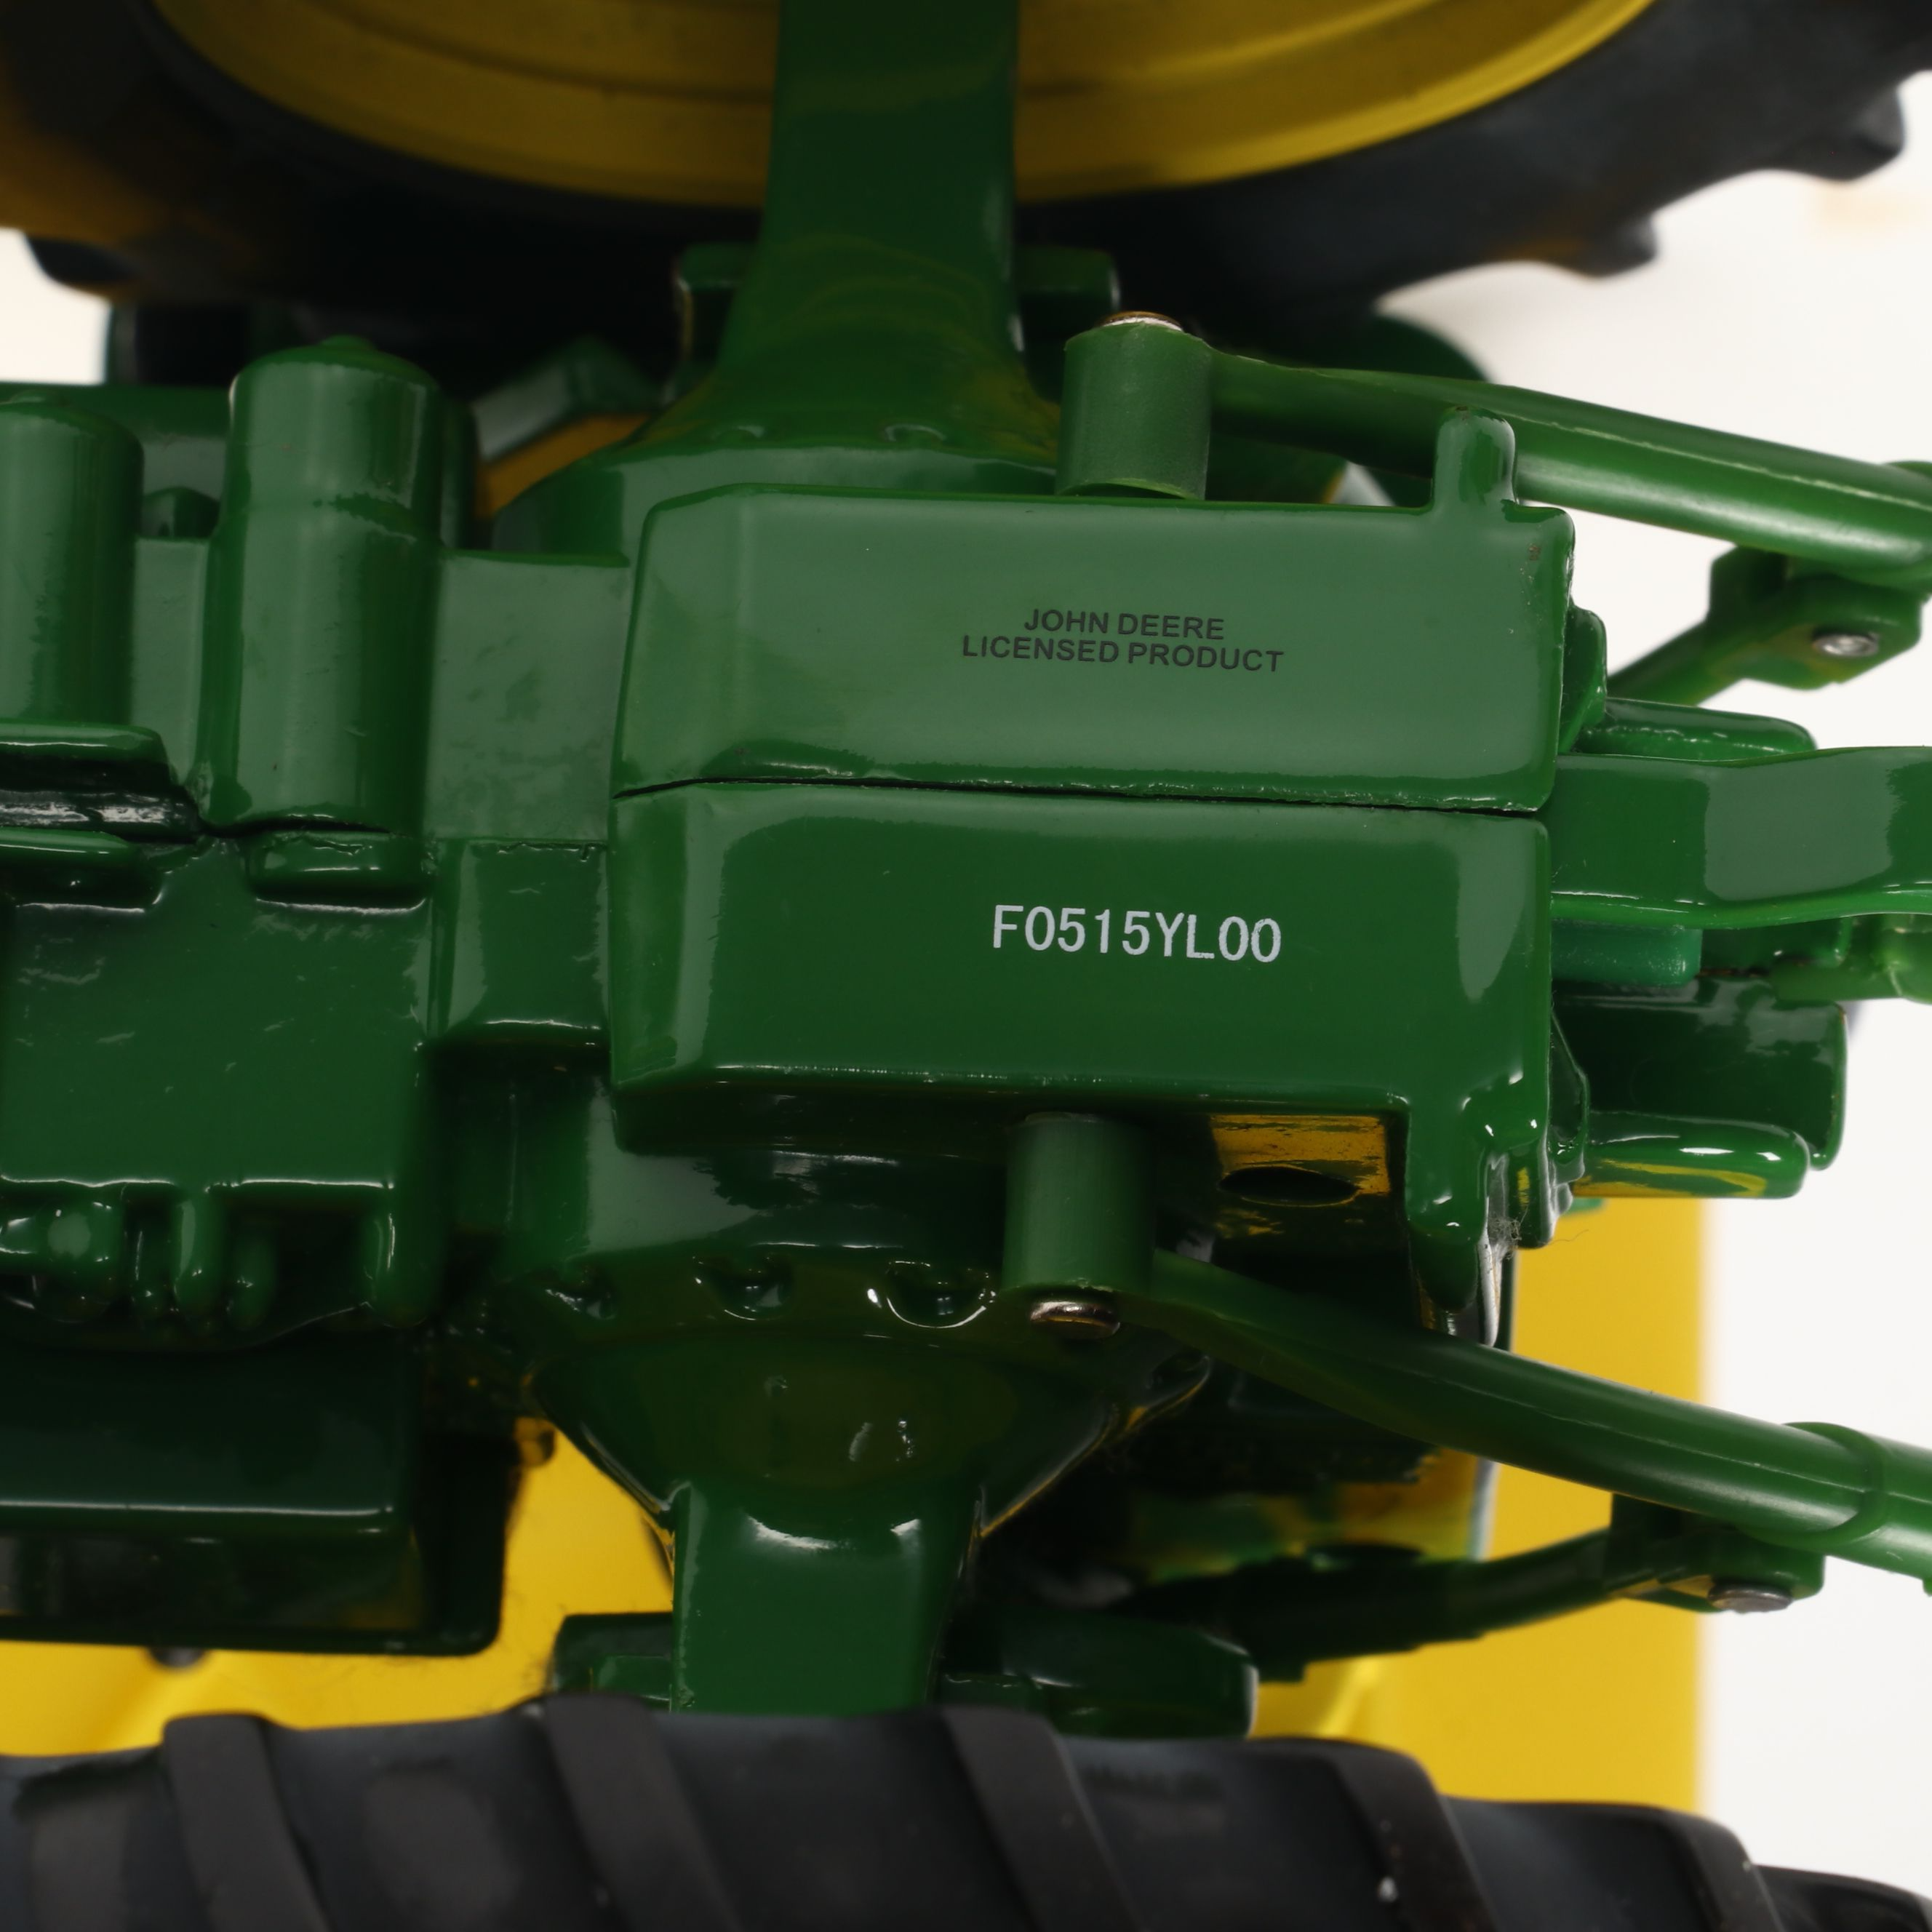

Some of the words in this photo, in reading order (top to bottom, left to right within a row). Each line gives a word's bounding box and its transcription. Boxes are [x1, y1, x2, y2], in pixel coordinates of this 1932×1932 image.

[1023, 608, 1109, 634] JOHN
[1117, 612, 1225, 640] DEERE
[962, 634, 1119, 663] LICENSED
[1127, 642, 1285, 672] PRODUCT
[993, 904, 1282, 963] F0515YL00
